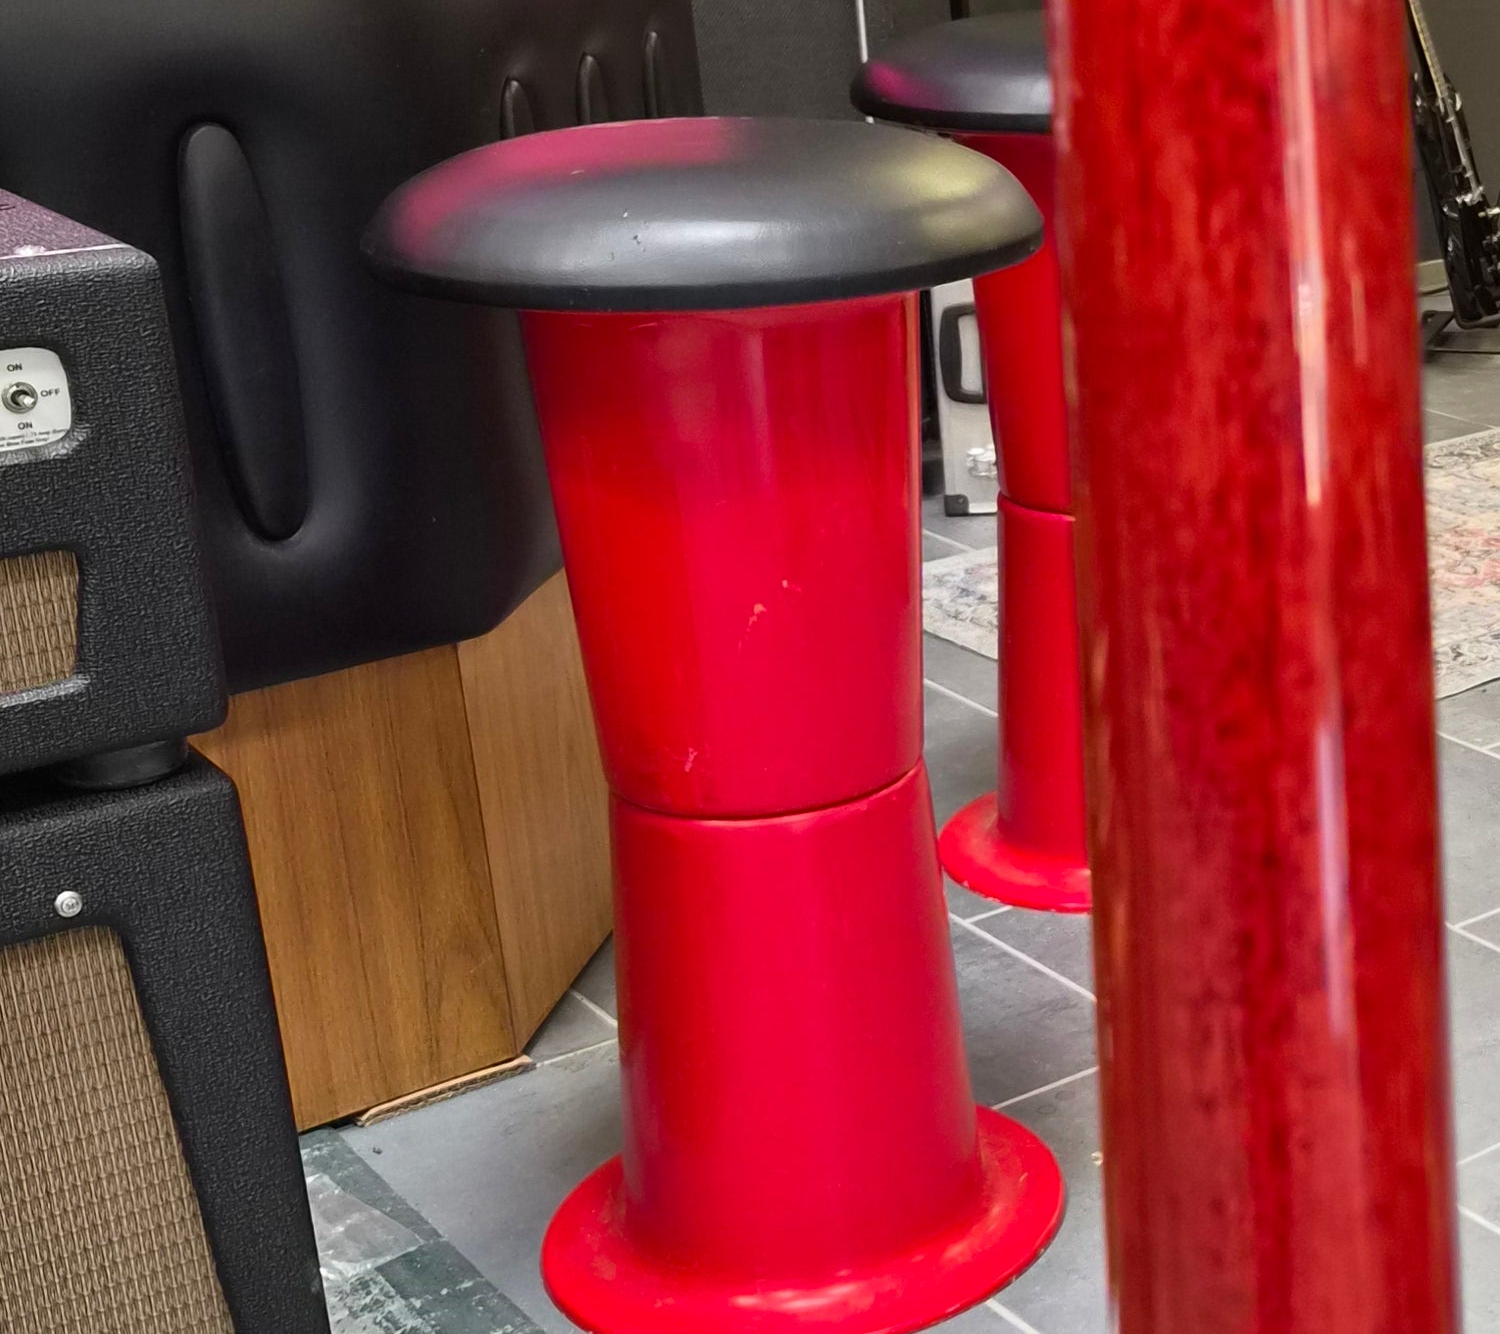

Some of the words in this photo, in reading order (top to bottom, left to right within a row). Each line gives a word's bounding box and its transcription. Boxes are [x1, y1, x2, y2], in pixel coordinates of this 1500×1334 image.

[6, 363, 23, 372] ON
[40, 388, 60, 397] OFF
[17, 422, 33, 430] ON
